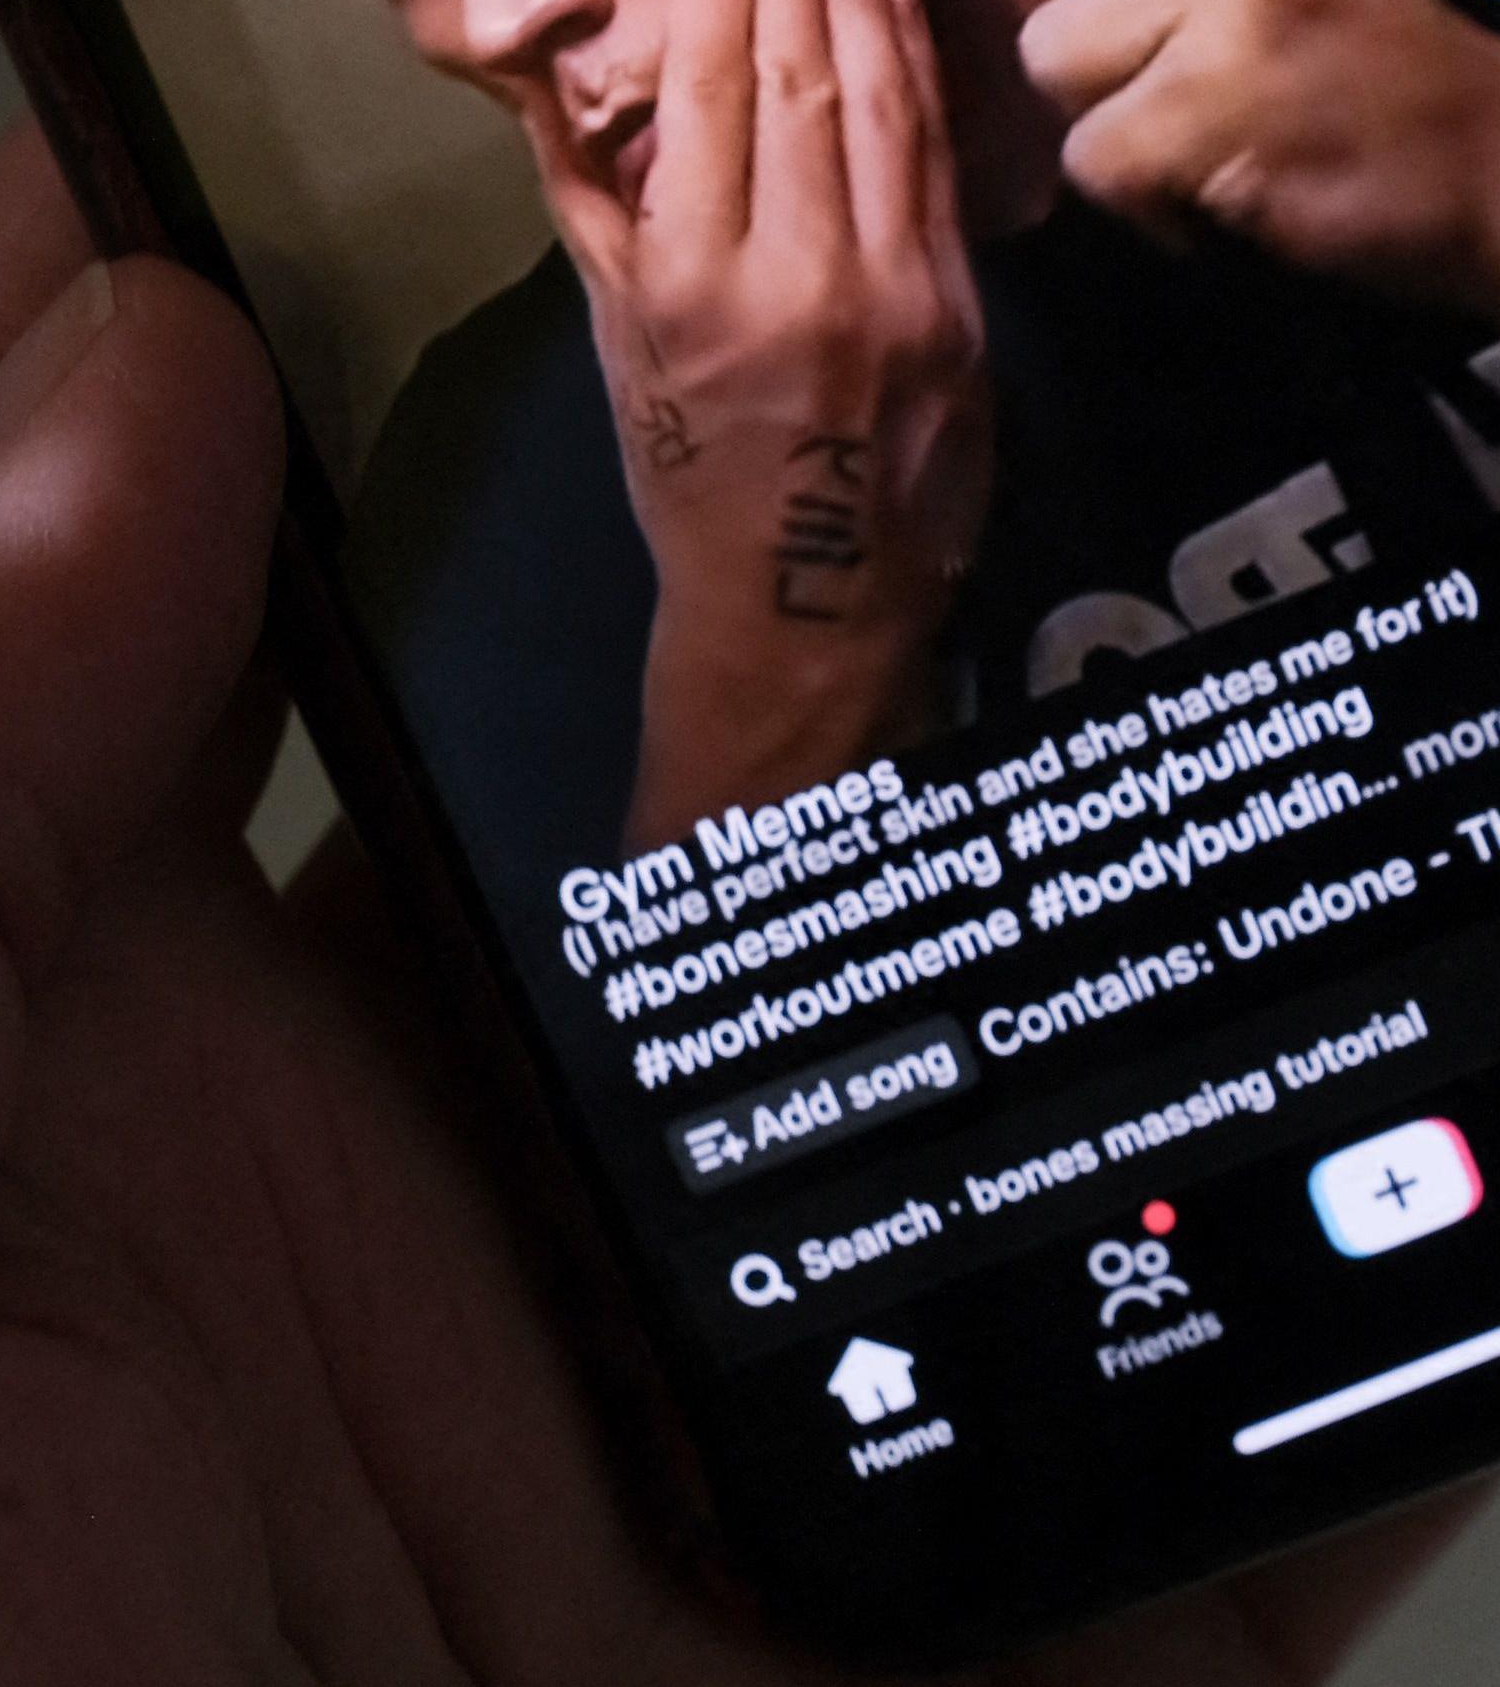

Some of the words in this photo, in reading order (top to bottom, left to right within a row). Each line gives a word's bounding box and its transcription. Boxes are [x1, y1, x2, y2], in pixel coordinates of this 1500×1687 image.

[558, 843, 695, 919] Gym
[694, 759, 904, 871] Memes
[598, 889, 711, 958] have
[711, 817, 880, 922] perfect
[880, 783, 975, 845] skin
[974, 736, 1066, 808] and
[1065, 712, 1150, 770] she
[1146, 659, 1279, 736] hates
[1278, 629, 1355, 684] me
[1354, 597, 1423, 652] for
[1423, 568, 1479, 624] it)
[603, 834, 1003, 1023] #bonesmashing
[1006, 685, 1375, 861] #bodybuilding
[632, 907, 1022, 1091] #workoutmeme
[978, 941, 1215, 1057] Contains:
[1217, 857, 1418, 961] Undone
[751, 1078, 844, 1152] Add
[844, 1041, 960, 1112] song
[797, 1198, 944, 1282] Search
[964, 1139, 1101, 1215] bones
[1101, 1069, 1277, 1162] massing
[1274, 999, 1429, 1091] tutorial
[1095, 1311, 1225, 1380] Friends
[847, 1417, 955, 1479] Home
